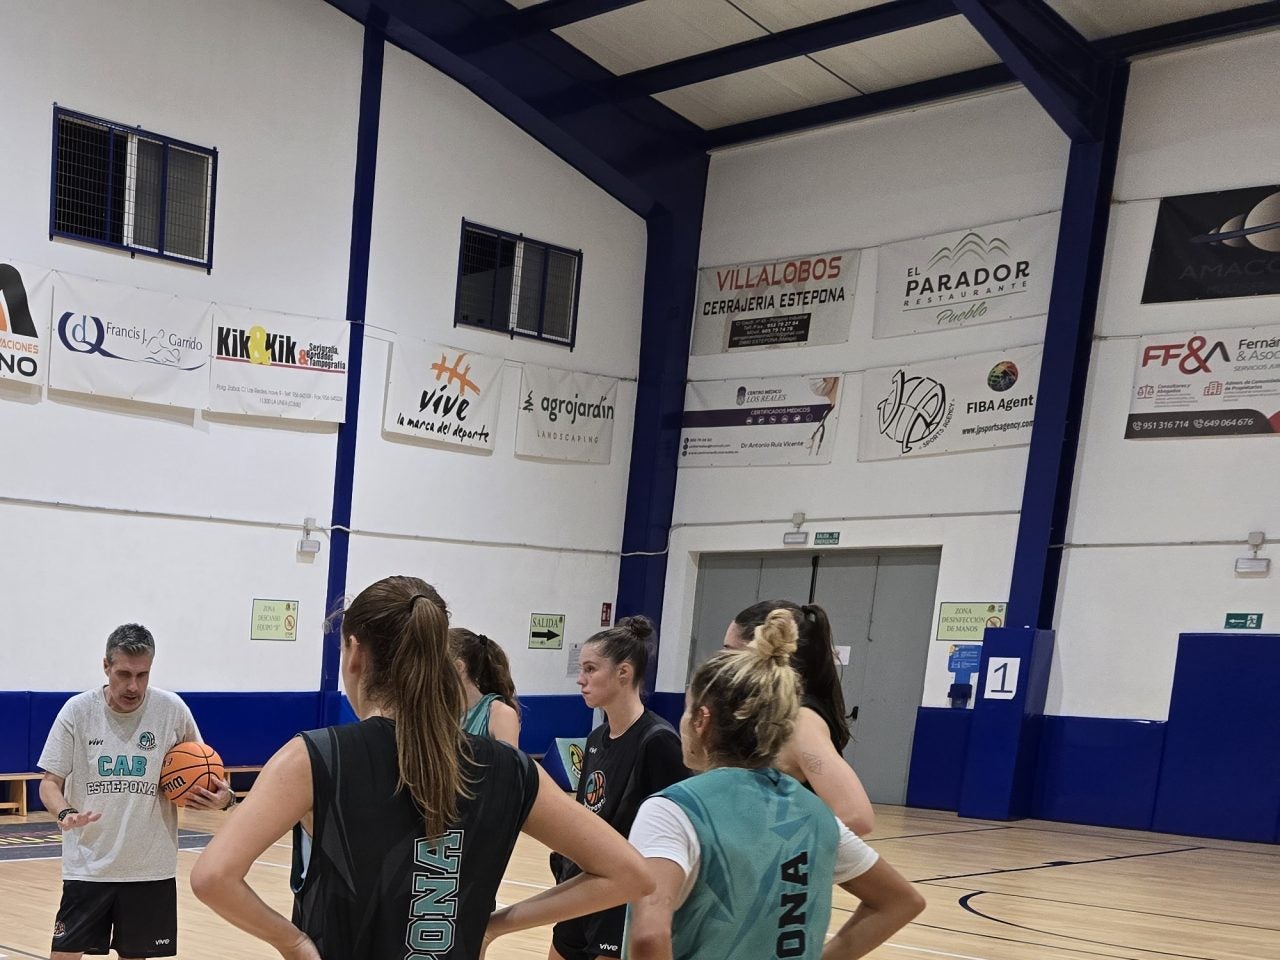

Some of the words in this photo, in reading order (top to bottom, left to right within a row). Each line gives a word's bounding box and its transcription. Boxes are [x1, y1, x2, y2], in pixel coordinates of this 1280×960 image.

[716, 255, 843, 292] VILLALOBOS
[905, 260, 1031, 298] PARADOR
[907, 266, 921, 278] EL
[702, 293, 775, 317] CERRAJERIA
[779, 286, 846, 309] ESTEPONA
[903, 279, 1028, 307] RESTAURANTE
[936, 301, 989, 326] Pueblo
[106, 321, 140, 339] Francis
[168, 333, 203, 351] Garrido
[1236, 350, 1246, 361] &
[540, 393, 615, 425] agrojardín
[966, 400, 995, 415] FIBA
[997, 395, 1035, 412] Agent
[397, 412, 405, 426] la
[406, 417, 435, 434] marca
[437, 421, 450, 435] del
[452, 424, 490, 444] deporte
[922, 428, 945, 448] SPORTS
[943, 402, 956, 428] AGENCY
[1142, 422, 1157, 430] 951
[1158, 421, 1172, 429] 316
[1174, 420, 1189, 429] 714
[1204, 419, 1219, 427] 649
[1220, 418, 1236, 427] 064
[1238, 418, 1254, 426] 676
[537, 430, 599, 445] LANDSCAPING
[748, 441, 770, 449] Antonio
[783, 440, 804, 448] Vicente
[532, 617, 559, 628] SALIDA
[942, 616, 985, 624] DESINFECCIÓN
[990, 662, 1013, 694] 1
[97, 755, 148, 777] CAB
[86, 780, 158, 796] ESTEPONA
